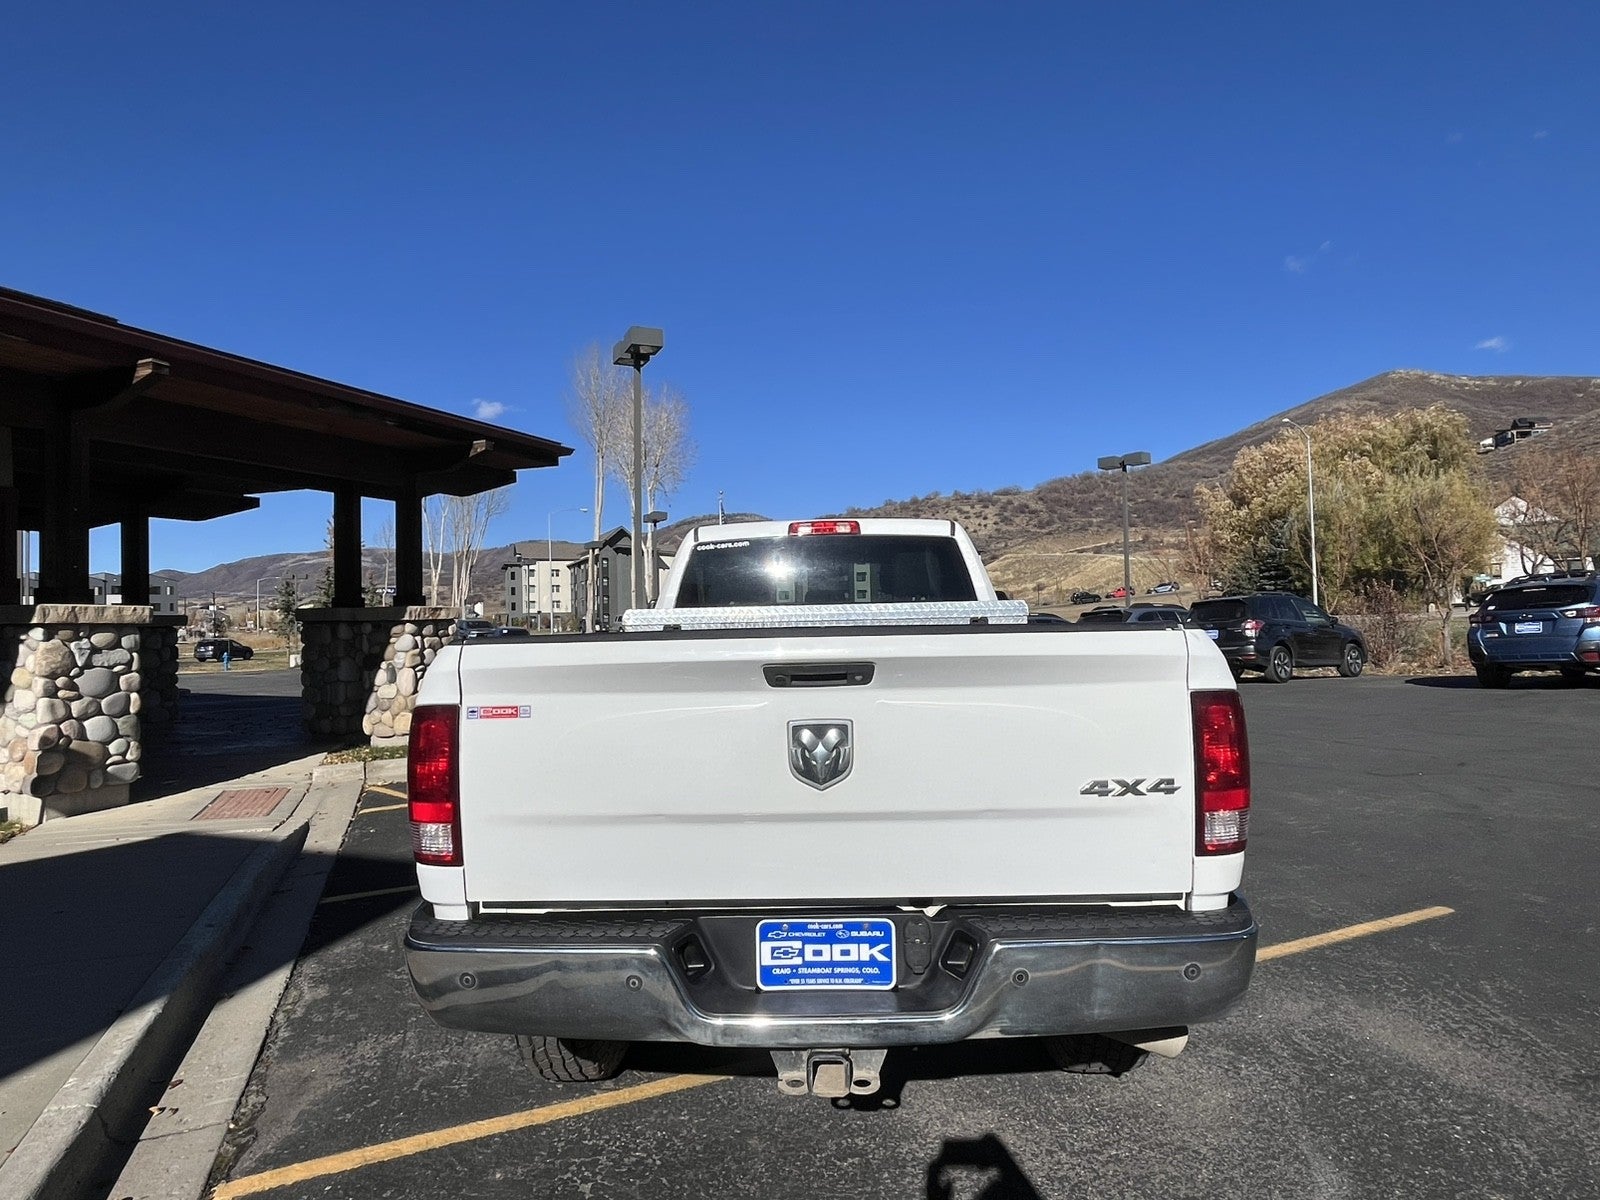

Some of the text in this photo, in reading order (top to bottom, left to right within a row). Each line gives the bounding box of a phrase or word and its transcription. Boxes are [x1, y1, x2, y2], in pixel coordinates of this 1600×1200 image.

[696, 541, 749, 550] cook-cars.com
[1080, 778, 1182, 797] 4X4
[807, 922, 844, 930] cook-cars.com
[760, 941, 891, 966] COOK
